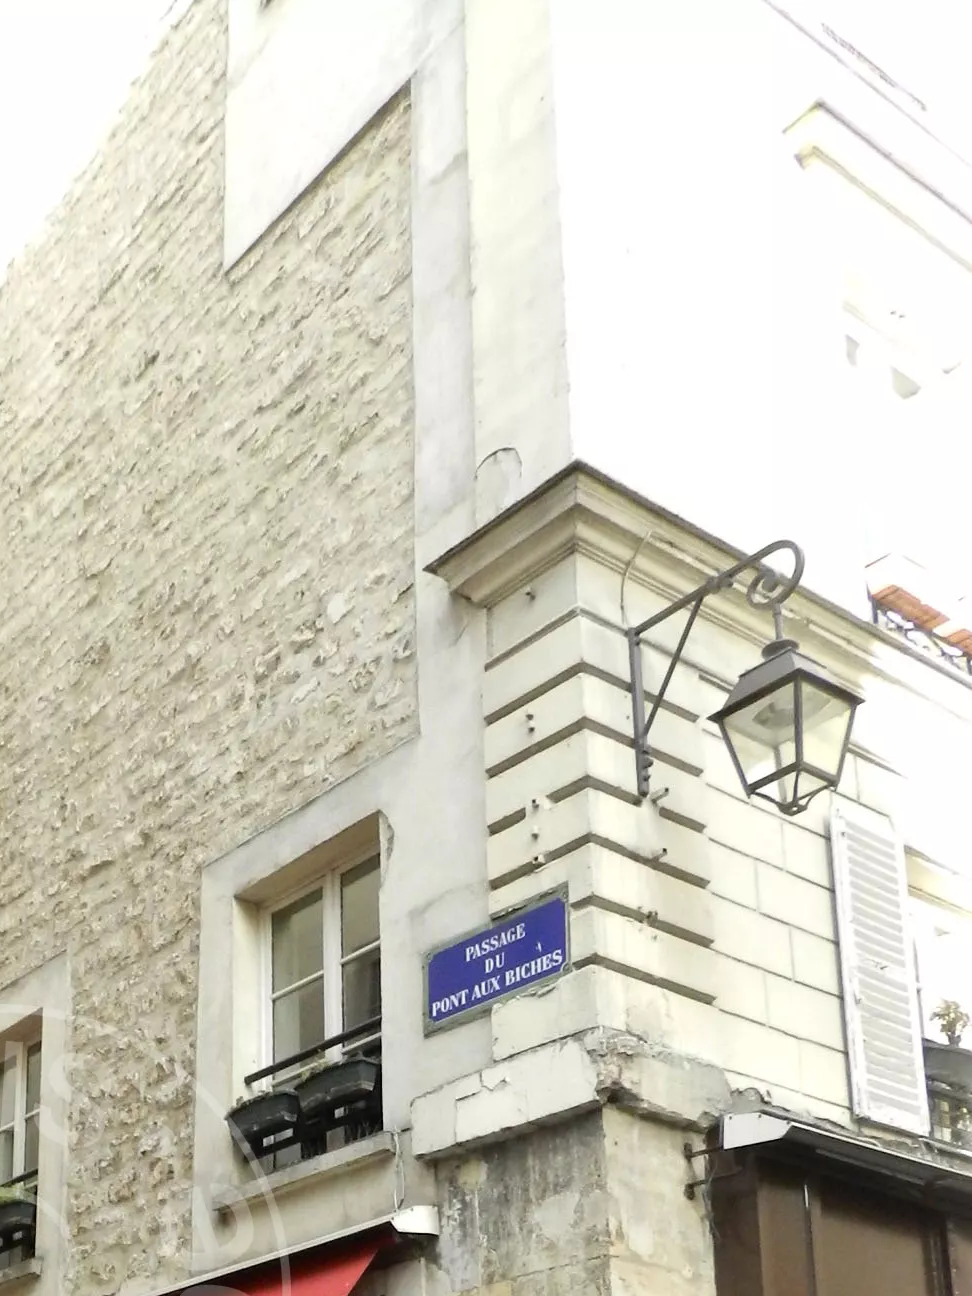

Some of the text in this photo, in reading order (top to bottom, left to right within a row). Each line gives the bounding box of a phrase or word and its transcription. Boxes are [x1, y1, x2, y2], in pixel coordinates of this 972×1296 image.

[465, 922, 526, 962] PASSAGE
[431, 949, 563, 1017] PONT AUX BICHES
[484, 952, 505, 974] DU
